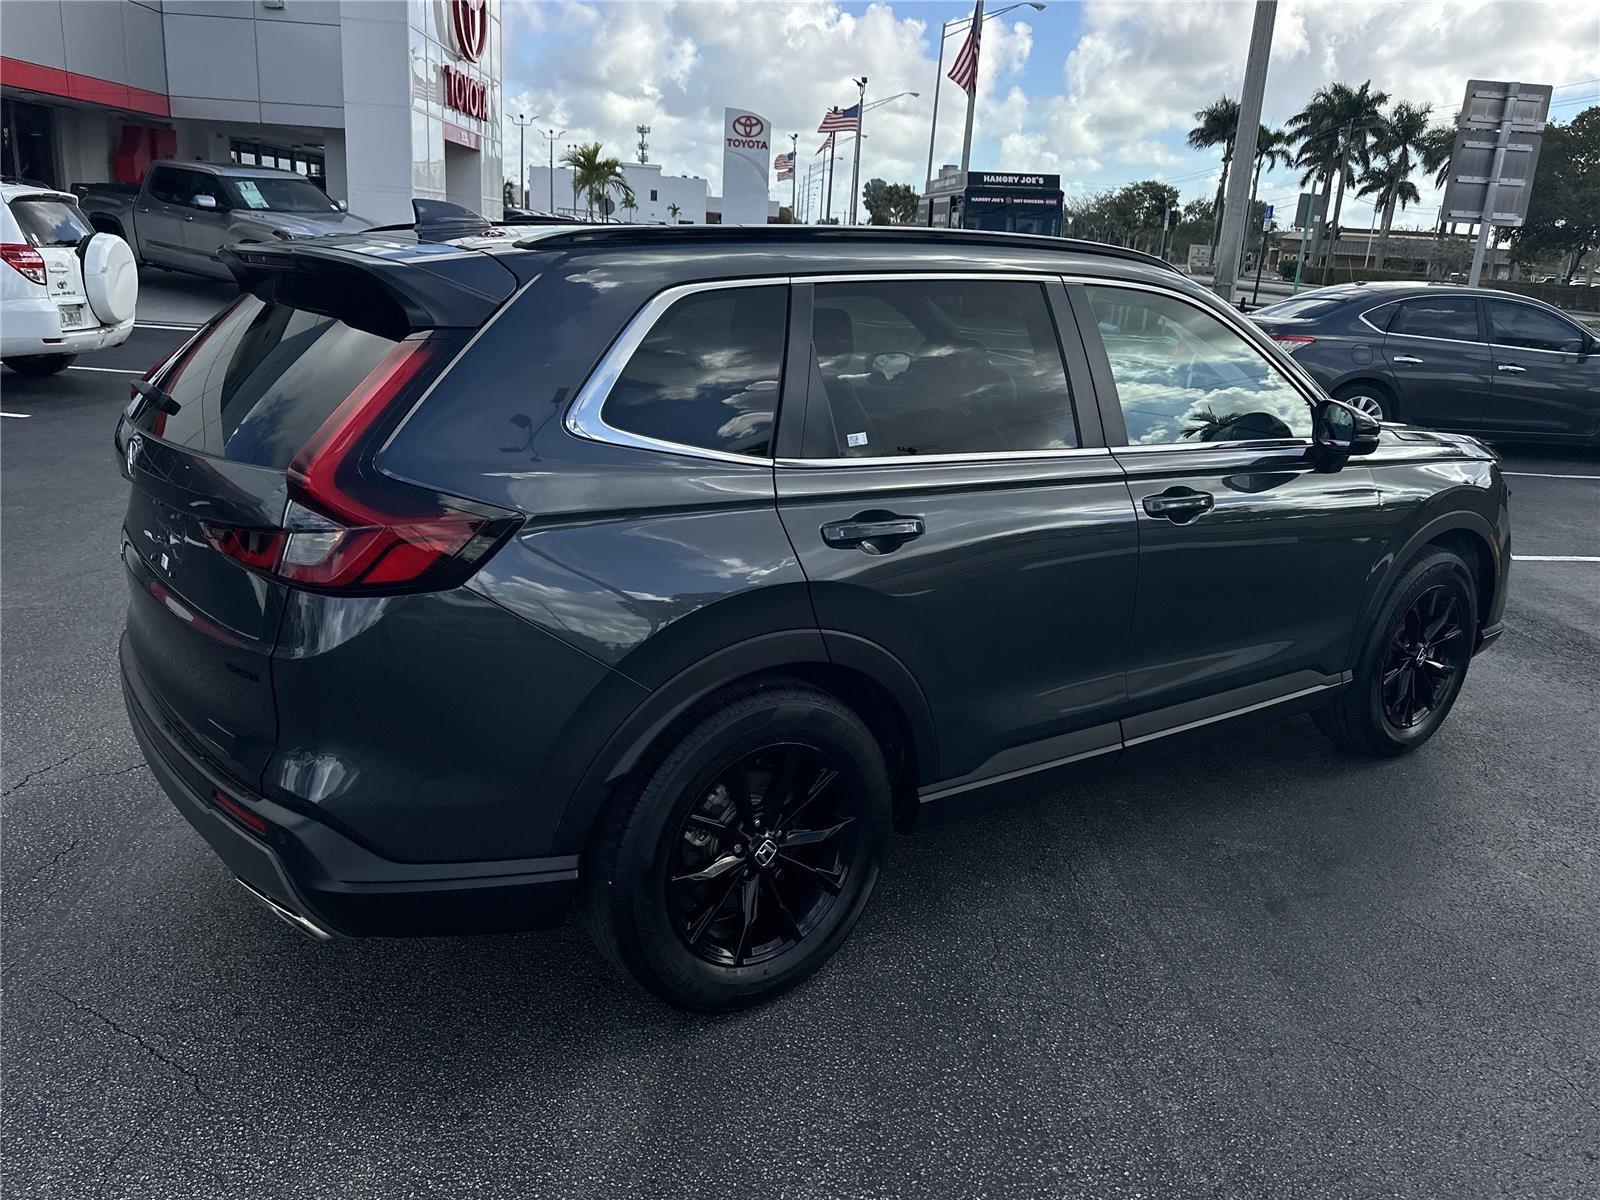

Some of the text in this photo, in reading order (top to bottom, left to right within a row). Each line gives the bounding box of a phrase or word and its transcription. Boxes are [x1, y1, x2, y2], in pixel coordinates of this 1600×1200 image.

[444, 65, 488, 122] TOYOTA
[726, 138, 768, 150] TOYOTA
[983, 174, 1044, 184] HANGRY JOE'S
